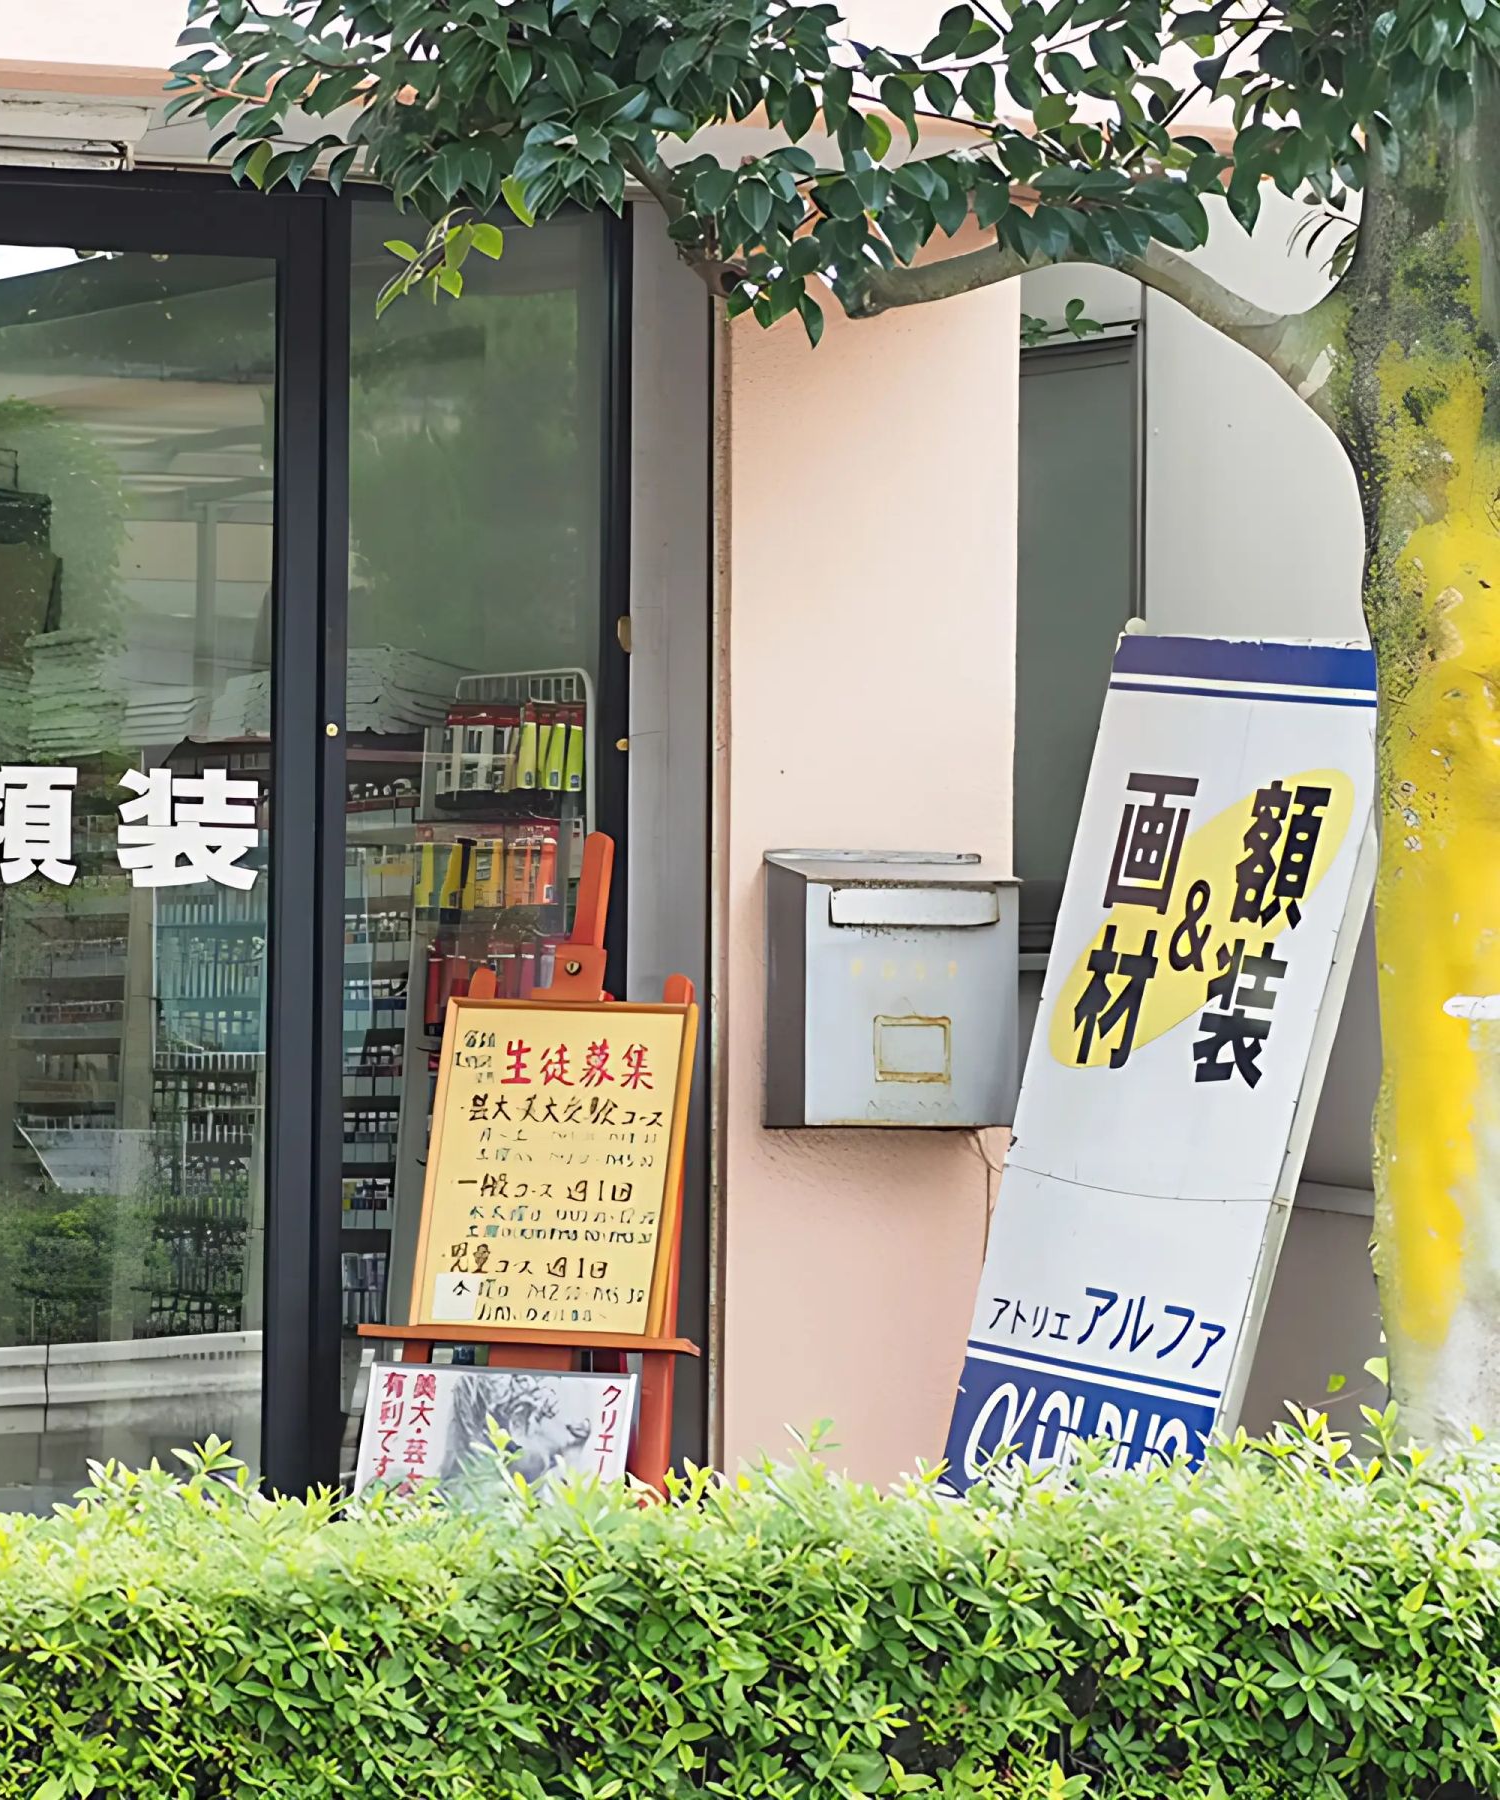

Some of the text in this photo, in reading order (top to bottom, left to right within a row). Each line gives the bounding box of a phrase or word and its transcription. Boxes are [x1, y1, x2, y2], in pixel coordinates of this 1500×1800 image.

[1168, 878, 1212, 973] &
[500, 1037, 655, 1090] 生徒募集
[988, 1286, 1227, 1370] アトリエ アルファ
